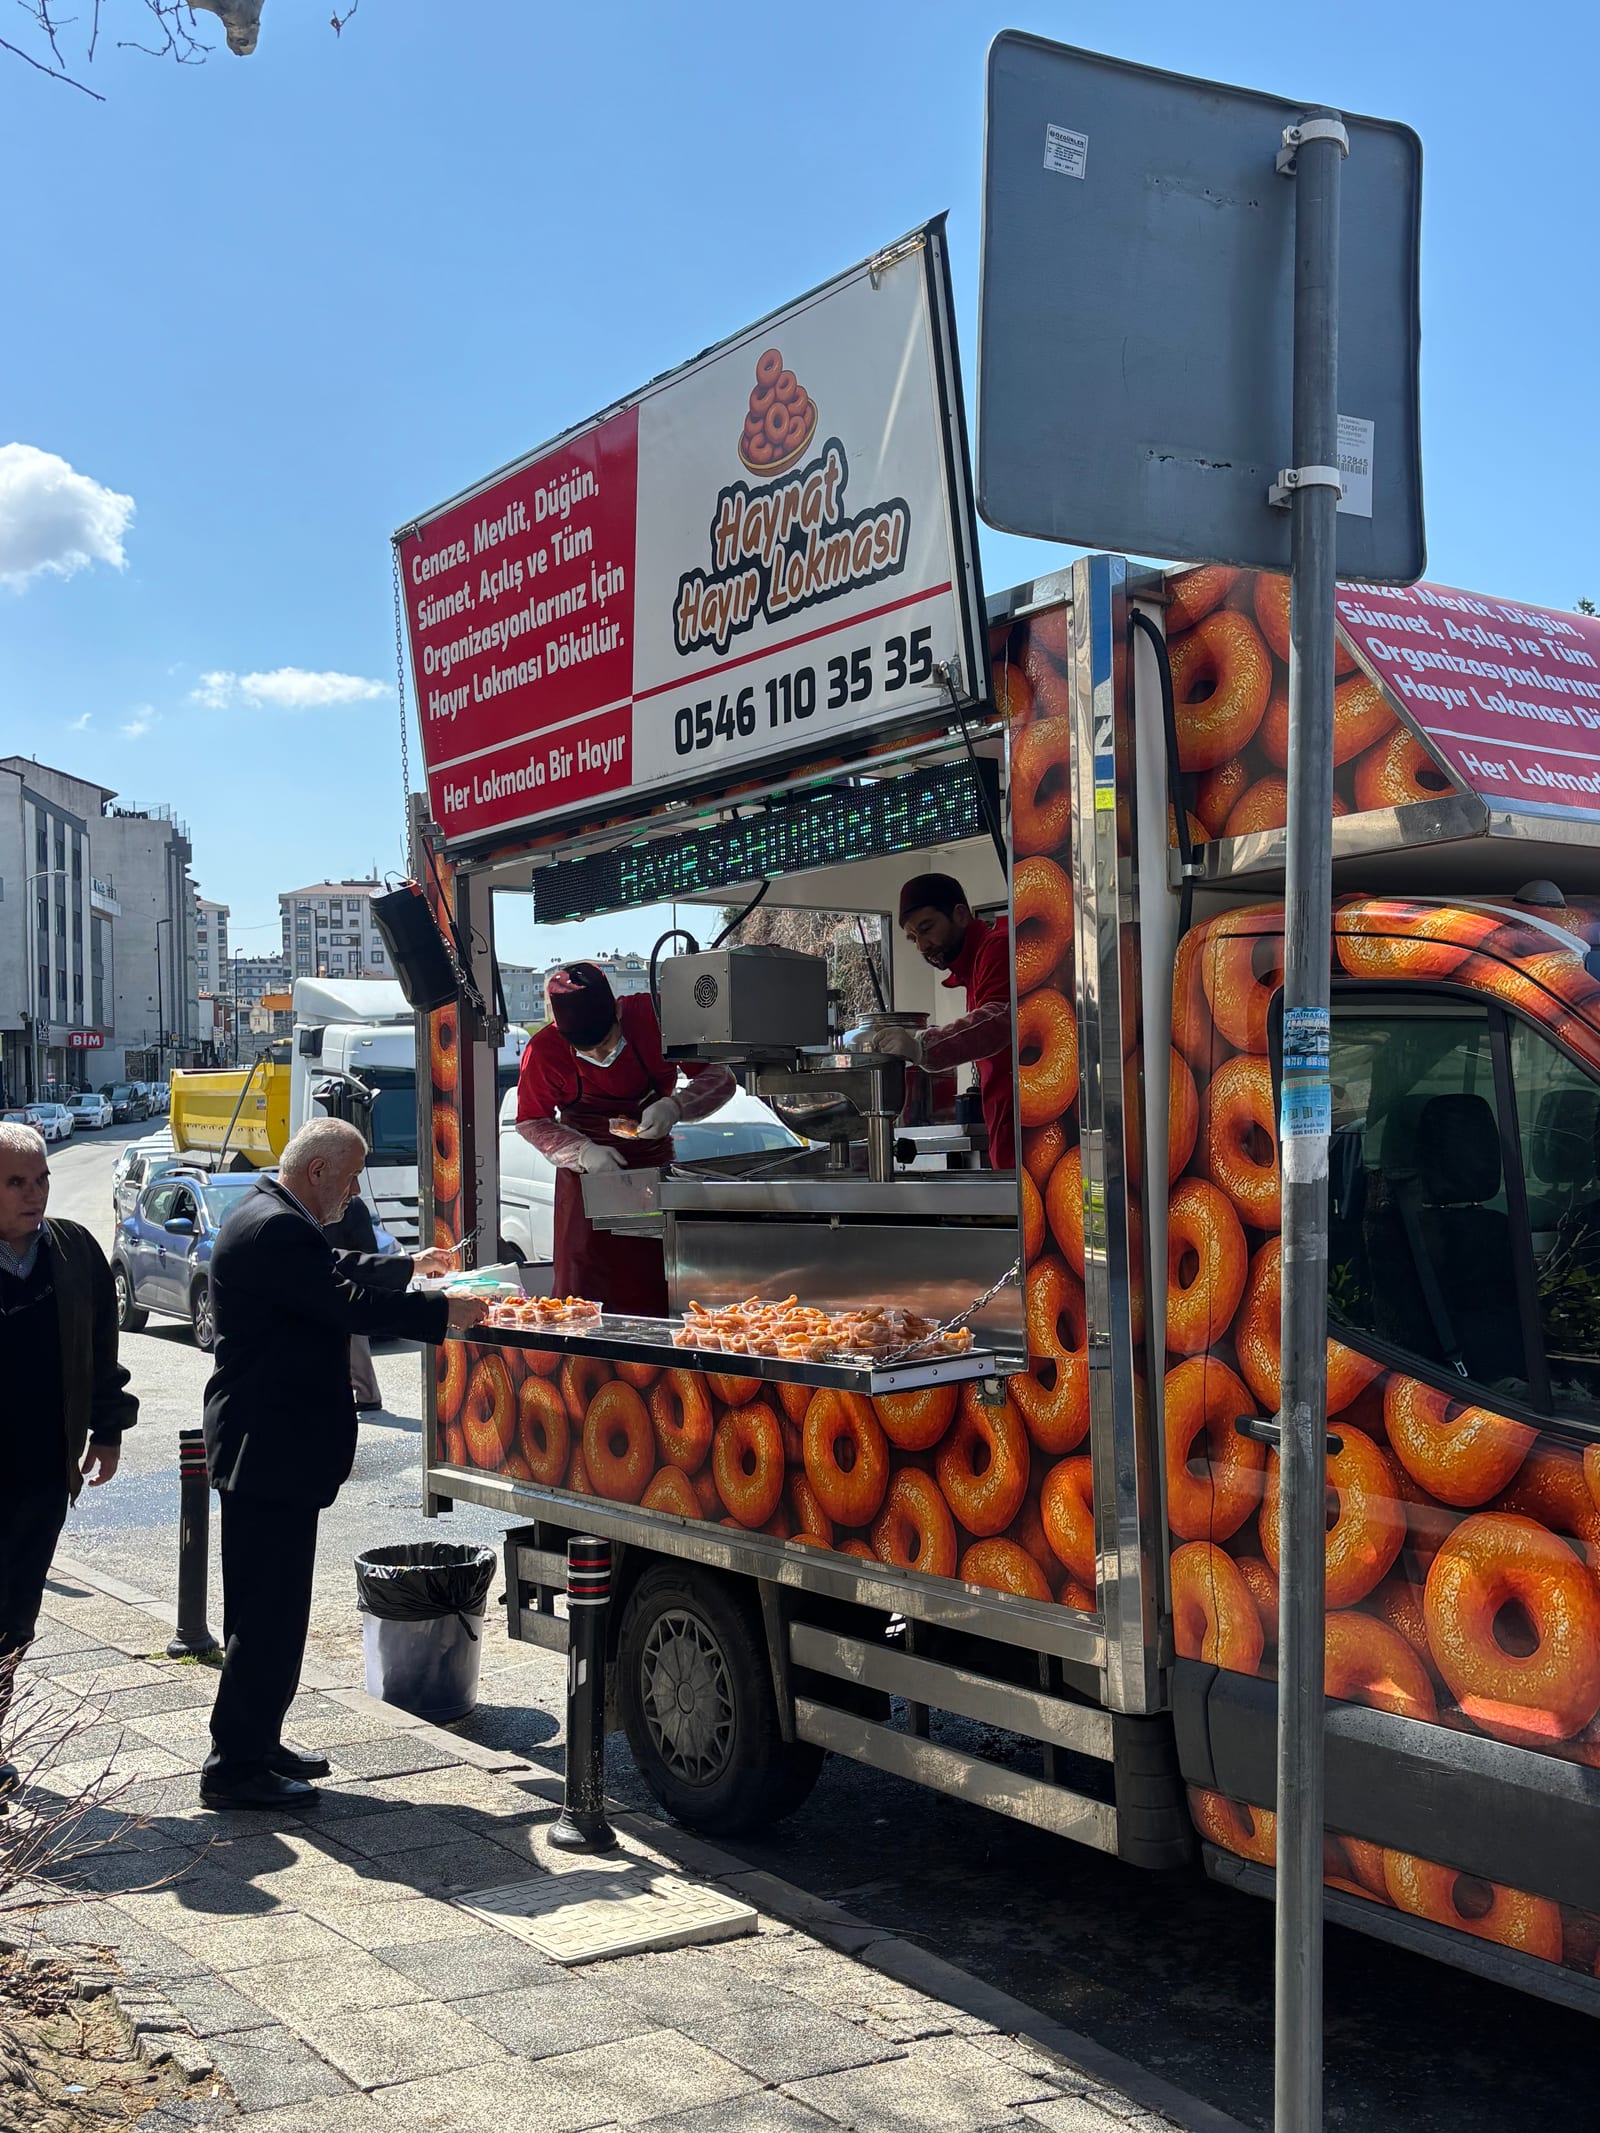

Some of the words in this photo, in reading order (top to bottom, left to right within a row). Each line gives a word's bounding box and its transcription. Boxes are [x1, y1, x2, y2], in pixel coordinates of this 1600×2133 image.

[412, 538, 470, 586] Cenaze,
[473, 501, 531, 556] Mevlit,
[534, 467, 600, 523] Düğün,
[716, 453, 840, 567] Hayrat
[417, 581, 476, 632] Sünnet,
[479, 558, 524, 605] Açılış
[526, 548, 548, 579] ve
[551, 524, 593, 567] Tüm
[423, 583, 588, 678] Organizasyonlarınız
[590, 559, 625, 609] İçin
[679, 572, 758, 642] Hayır
[769, 513, 902, 608] Lokması
[1412, 586, 1505, 623] Mevlit,
[1495, 604, 1586, 641] Düğün,
[428, 684, 470, 722] Hayır
[473, 655, 543, 704] Lokması
[546, 615, 625, 676] Dökülür.
[1337, 600, 1445, 640] Sünnet,
[1443, 618, 1514, 657] Açılış
[1510, 636, 1545, 658] ve
[1538, 637, 1599, 669] Tüm
[674, 686, 756, 756] 0546
[765, 665, 816, 729] 110
[826, 646, 873, 710] 35
[884, 625, 933, 692] 35
[1393, 673, 1470, 711] Hayır
[1469, 686, 1579, 727] Lokması
[443, 783, 471, 814] Her
[473, 756, 546, 805] Lokmada
[549, 746, 574, 782] Bir
[577, 734, 626, 775] Hayır
[1458, 750, 1510, 782] Her
[72, 1032, 100, 1046] BİM
